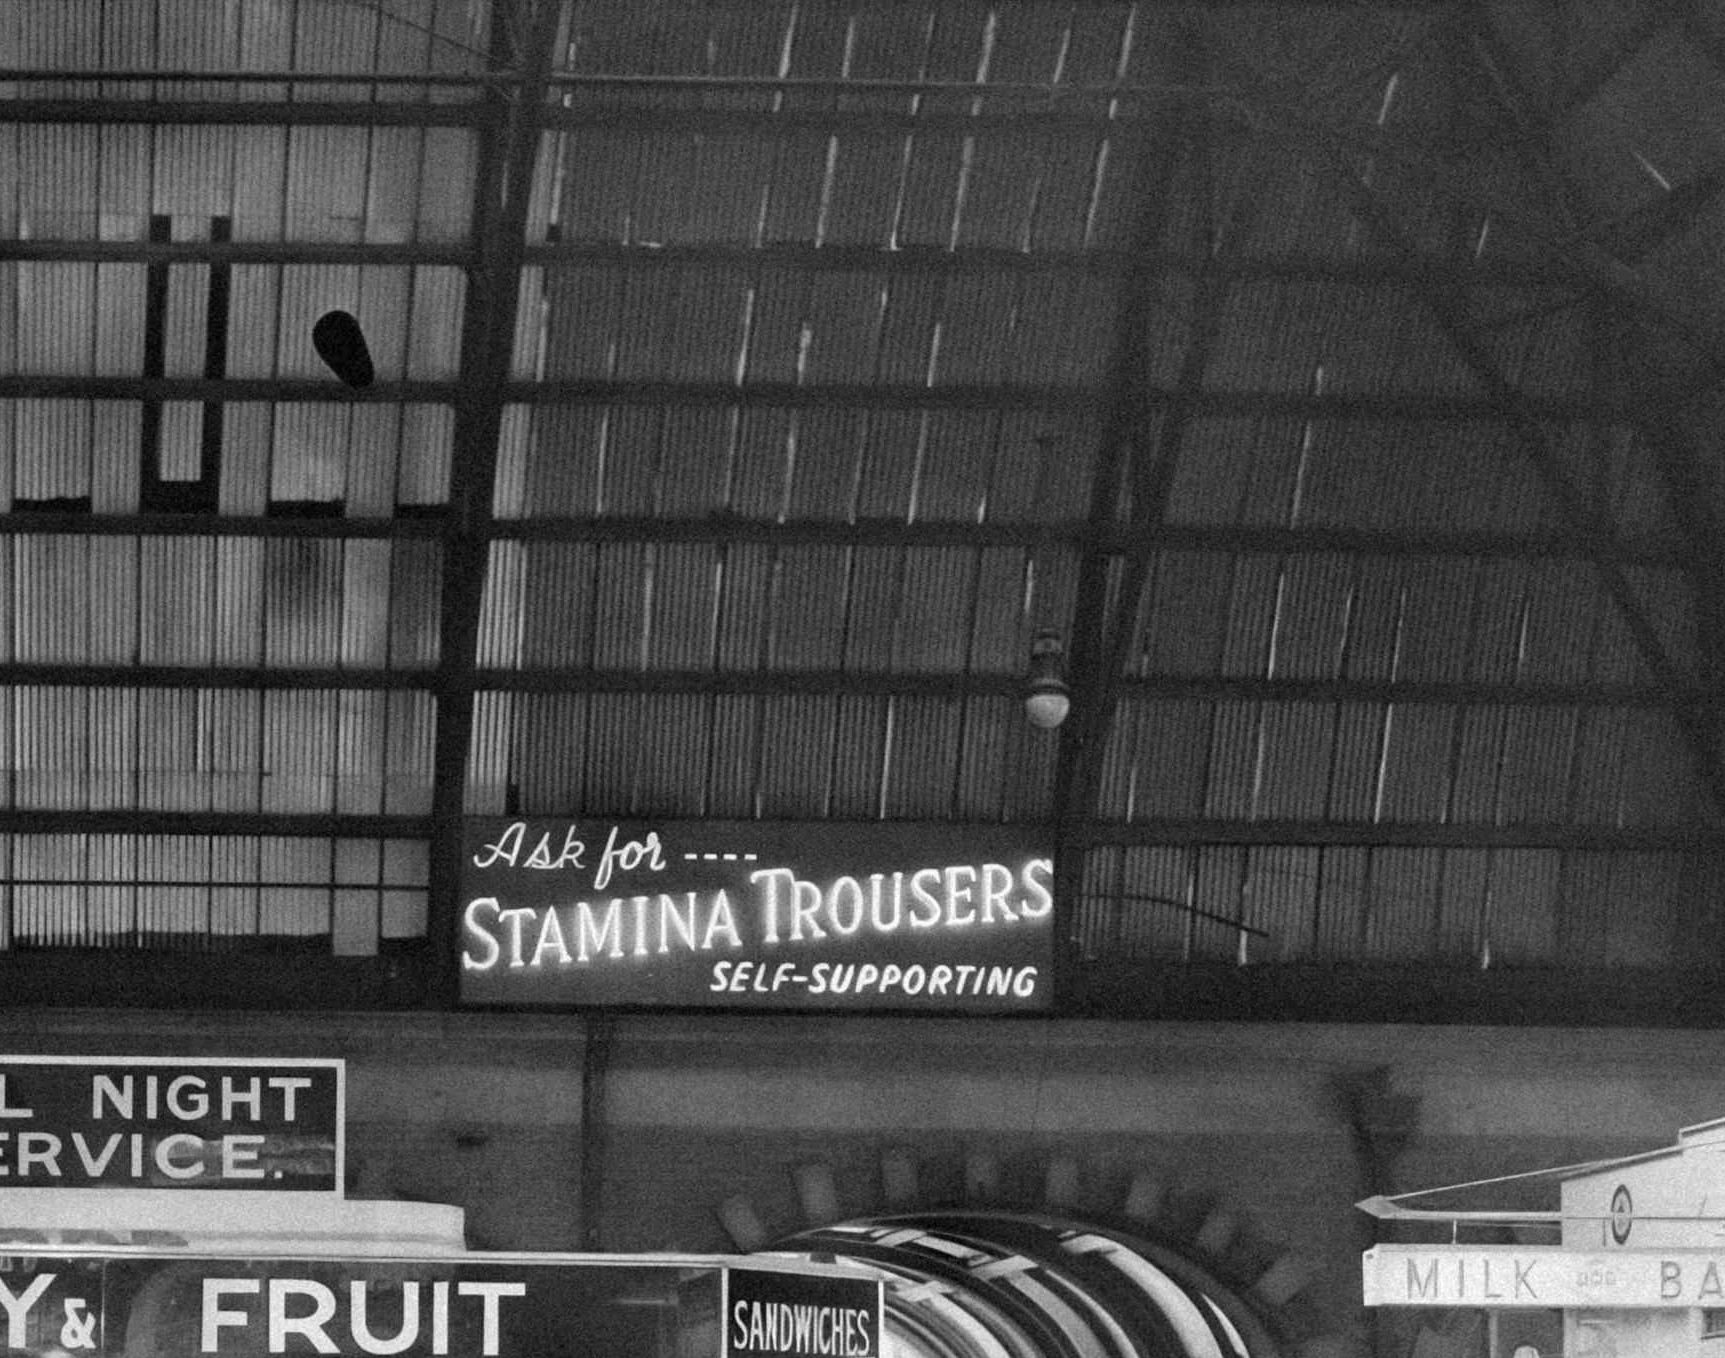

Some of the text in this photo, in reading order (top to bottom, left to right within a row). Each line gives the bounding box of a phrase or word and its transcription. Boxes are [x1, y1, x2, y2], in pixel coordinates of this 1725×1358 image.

[473, 821, 586, 869] Ask
[593, 824, 666, 890] for
[462, 858, 1054, 970] STAMINA TROUSERS
[709, 961, 1038, 997] SELF-SUPPORTING
[92, 1075, 313, 1121] NIGHT
[1407, 1257, 1538, 1300] MILK
[60, 1298, 96, 1349] &
[201, 1278, 527, 1356] FRUIT
[734, 1300, 870, 1357] SANDWICHES
